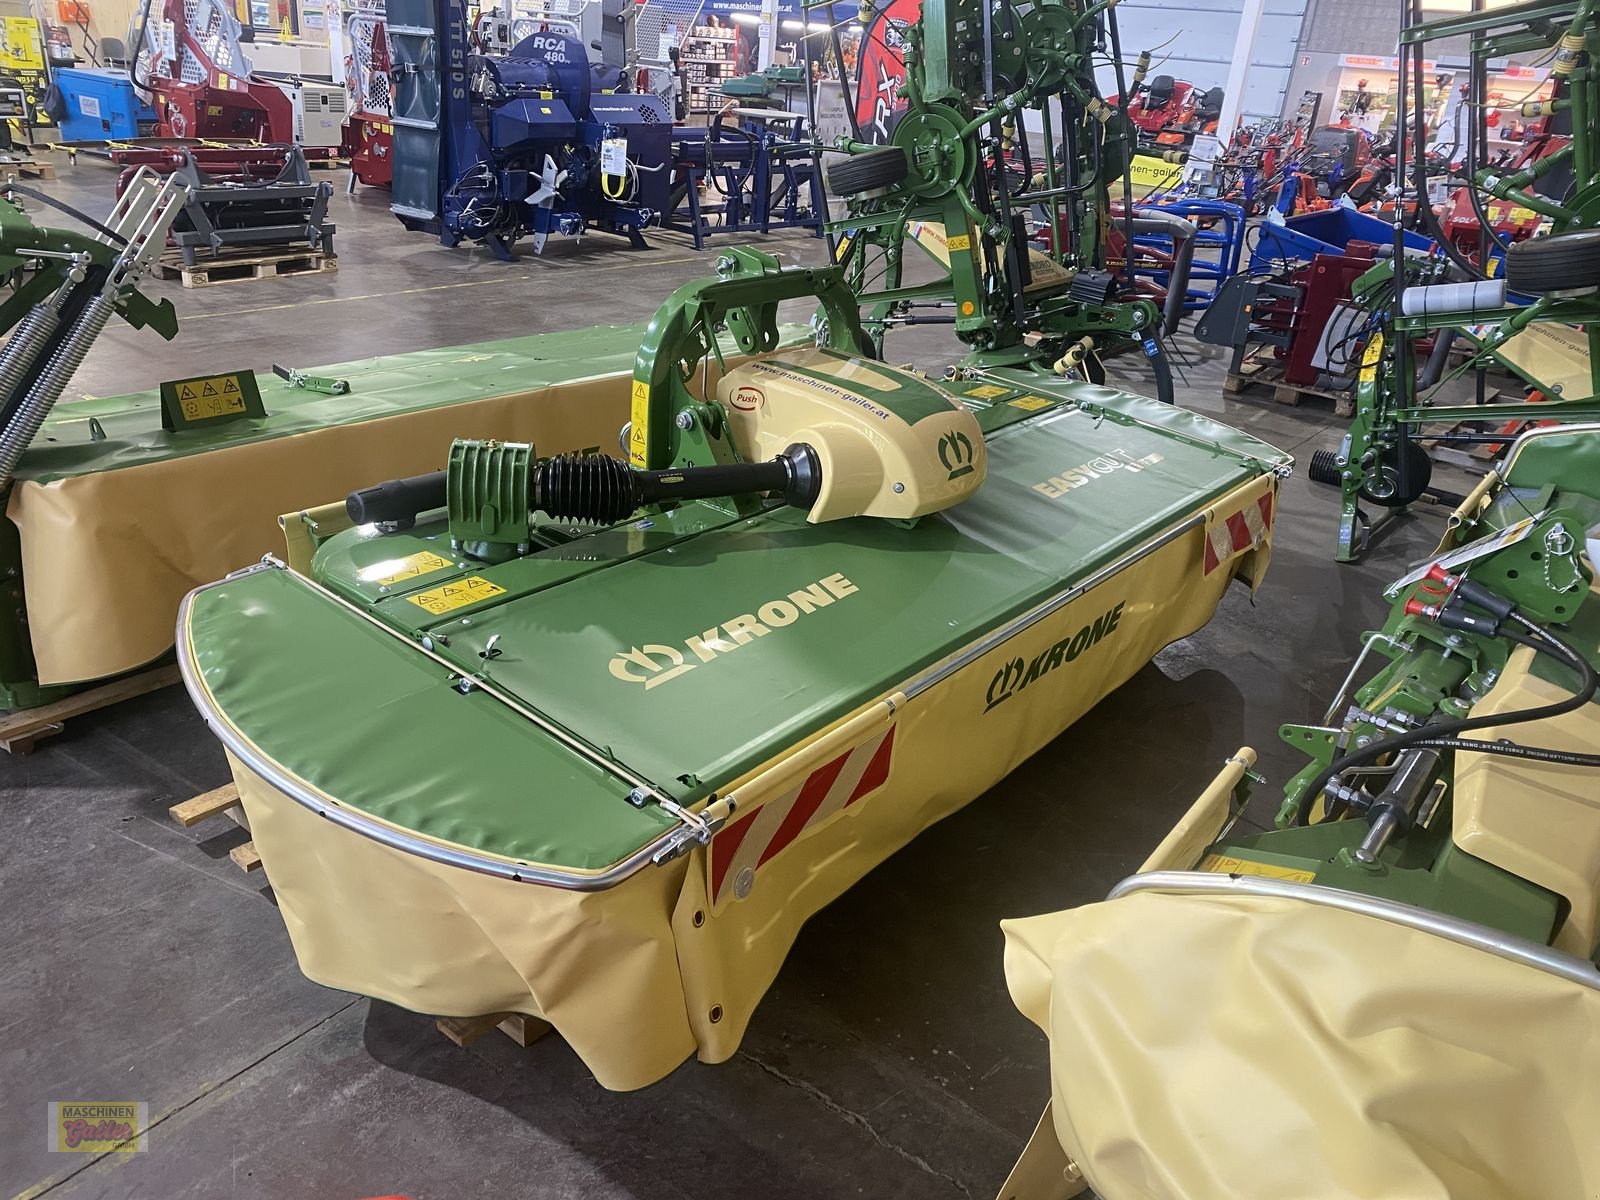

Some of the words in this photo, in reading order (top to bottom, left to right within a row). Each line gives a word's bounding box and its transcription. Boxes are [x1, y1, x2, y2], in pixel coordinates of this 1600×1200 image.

[533, 36, 566, 52] RCA
[543, 51, 566, 62] 480
[736, 393, 758, 404] Push
[751, 362, 890, 421] www.maschinen-gailer.at
[684, 572, 860, 664] KRONE
[1017, 599, 1127, 692] KRONE
